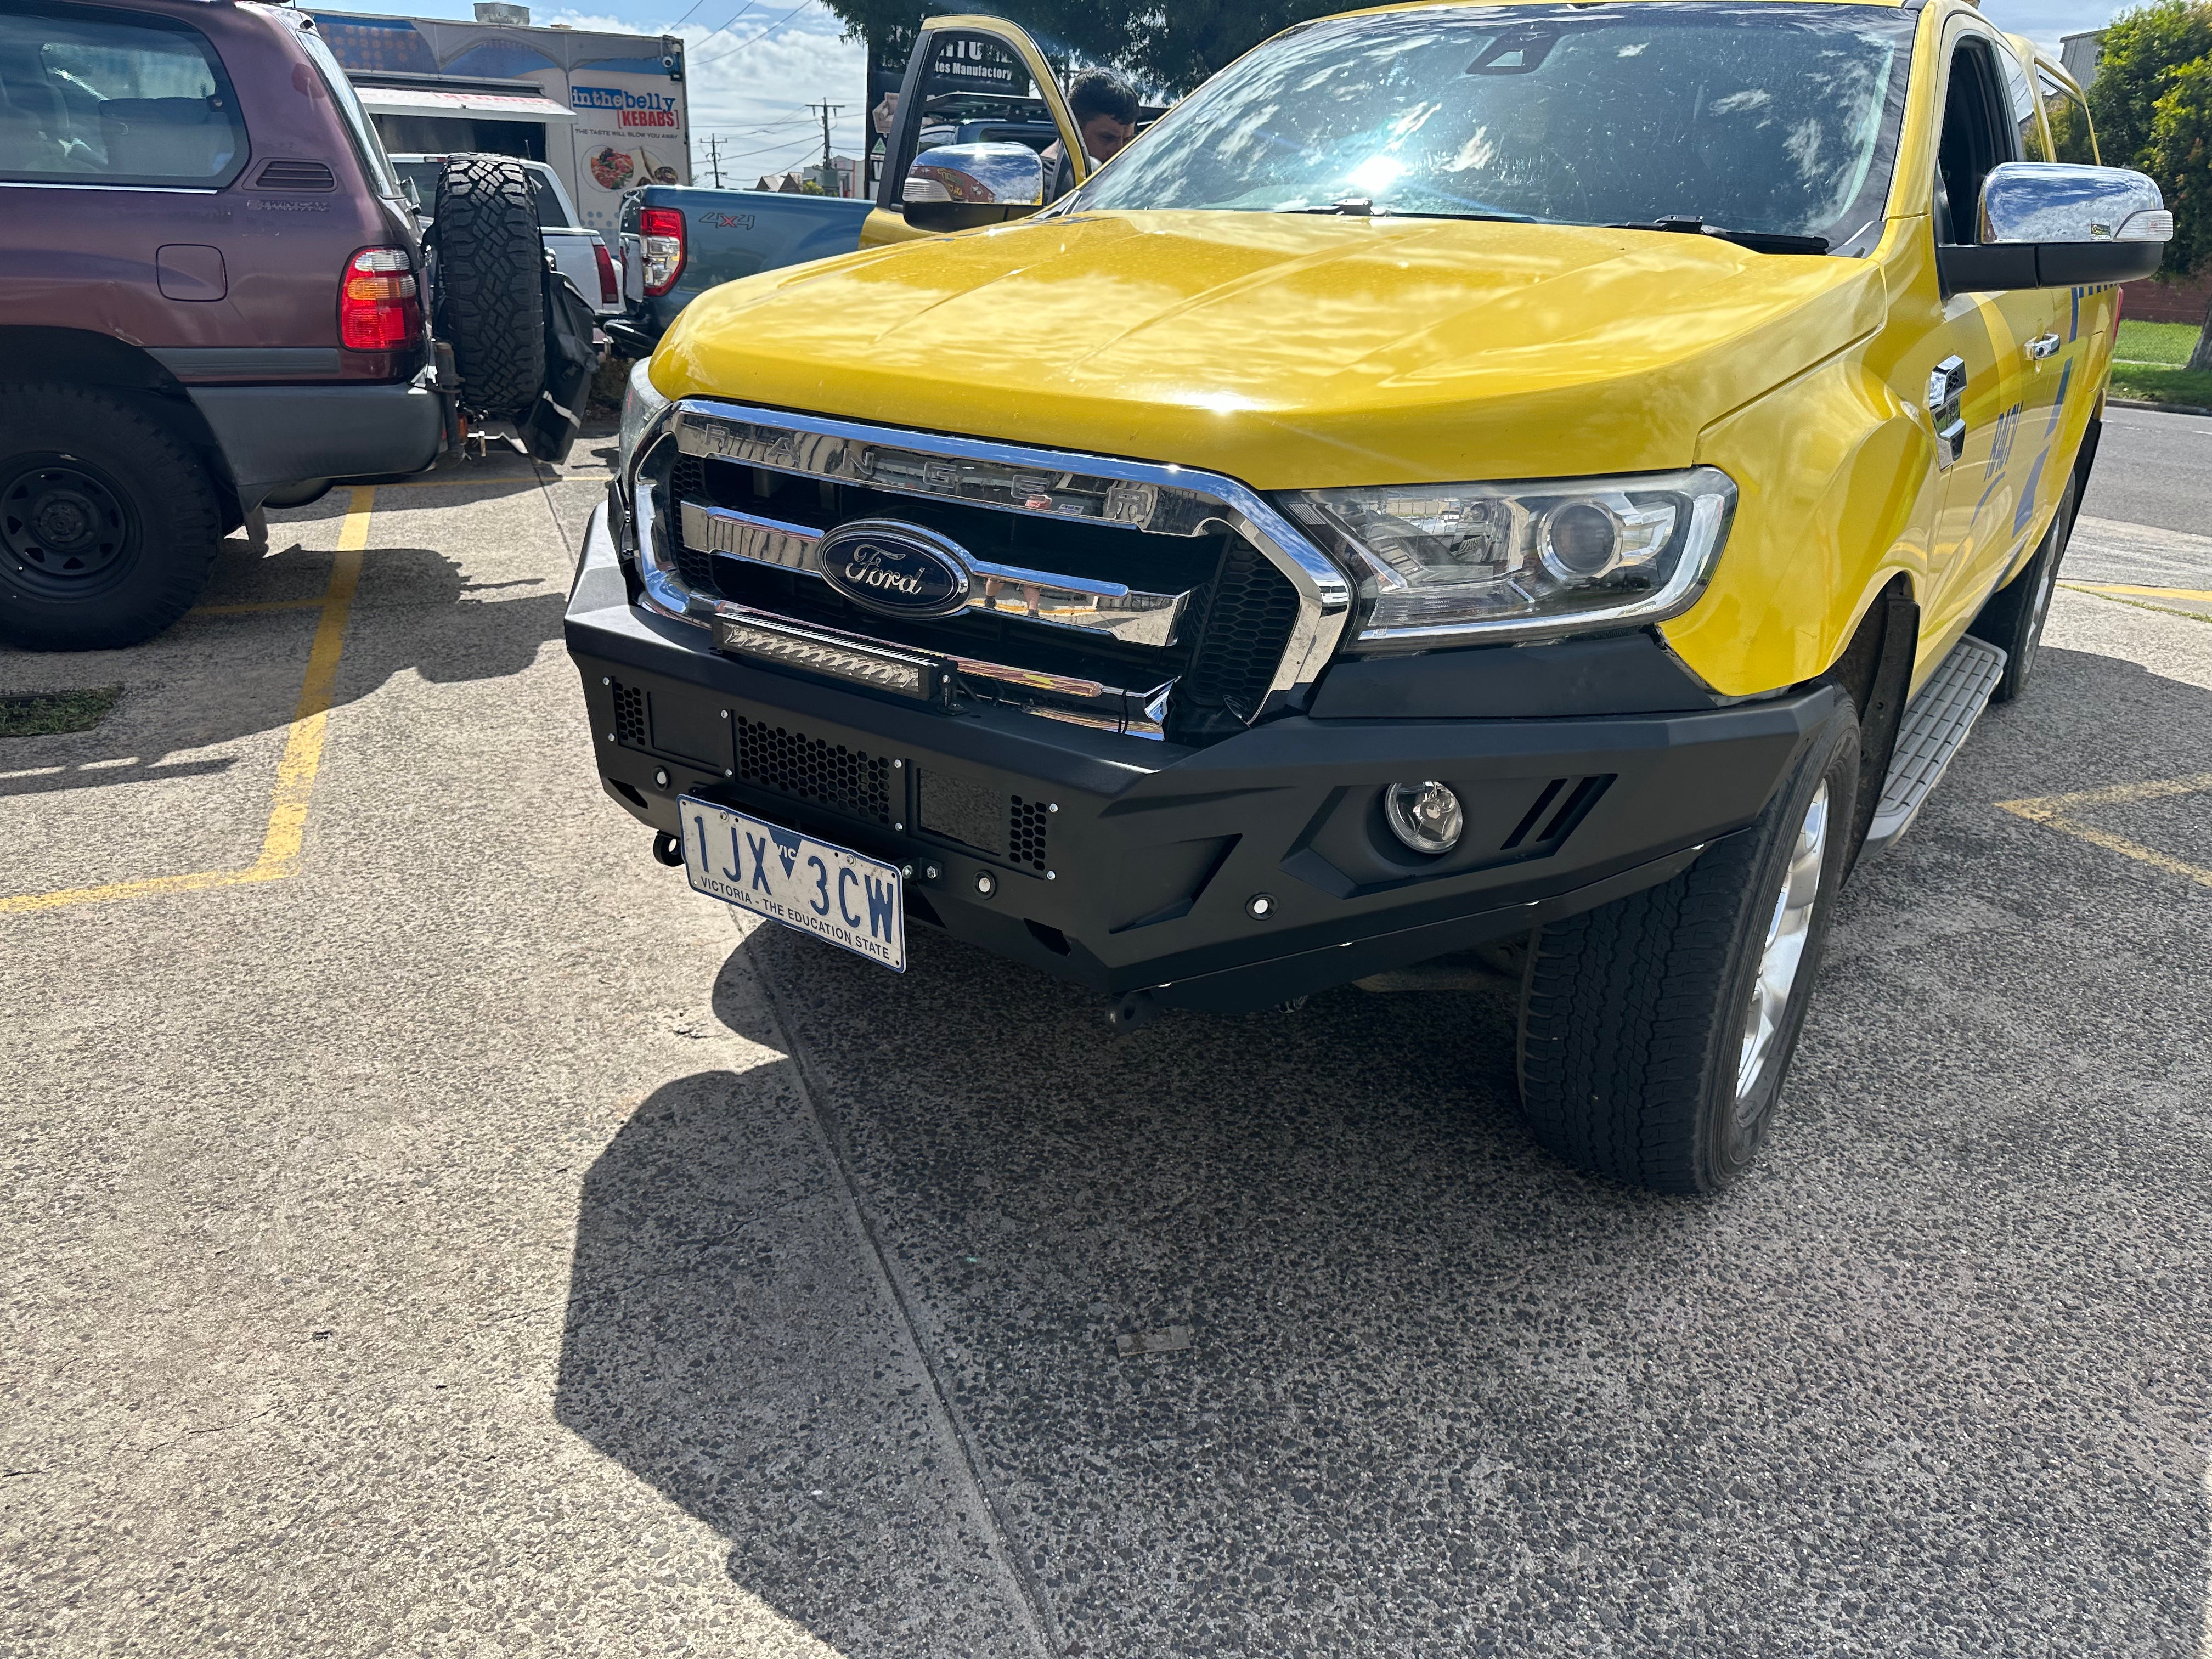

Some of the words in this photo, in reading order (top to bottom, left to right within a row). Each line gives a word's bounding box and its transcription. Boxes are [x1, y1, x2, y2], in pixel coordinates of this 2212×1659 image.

[952, 62, 1012, 81] Manufactory
[704, 423, 1150, 517] RANGER
[845, 544, 926, 596] Ford
[694, 815, 772, 896] 1JX
[808, 856, 894, 945] 3CW
[776, 844, 798, 861] VIC
[700, 876, 752, 905] VICTORIA
[762, 898, 785, 917] THE
[788, 907, 852, 946] EDUCATION
[855, 935, 890, 960] STATE
